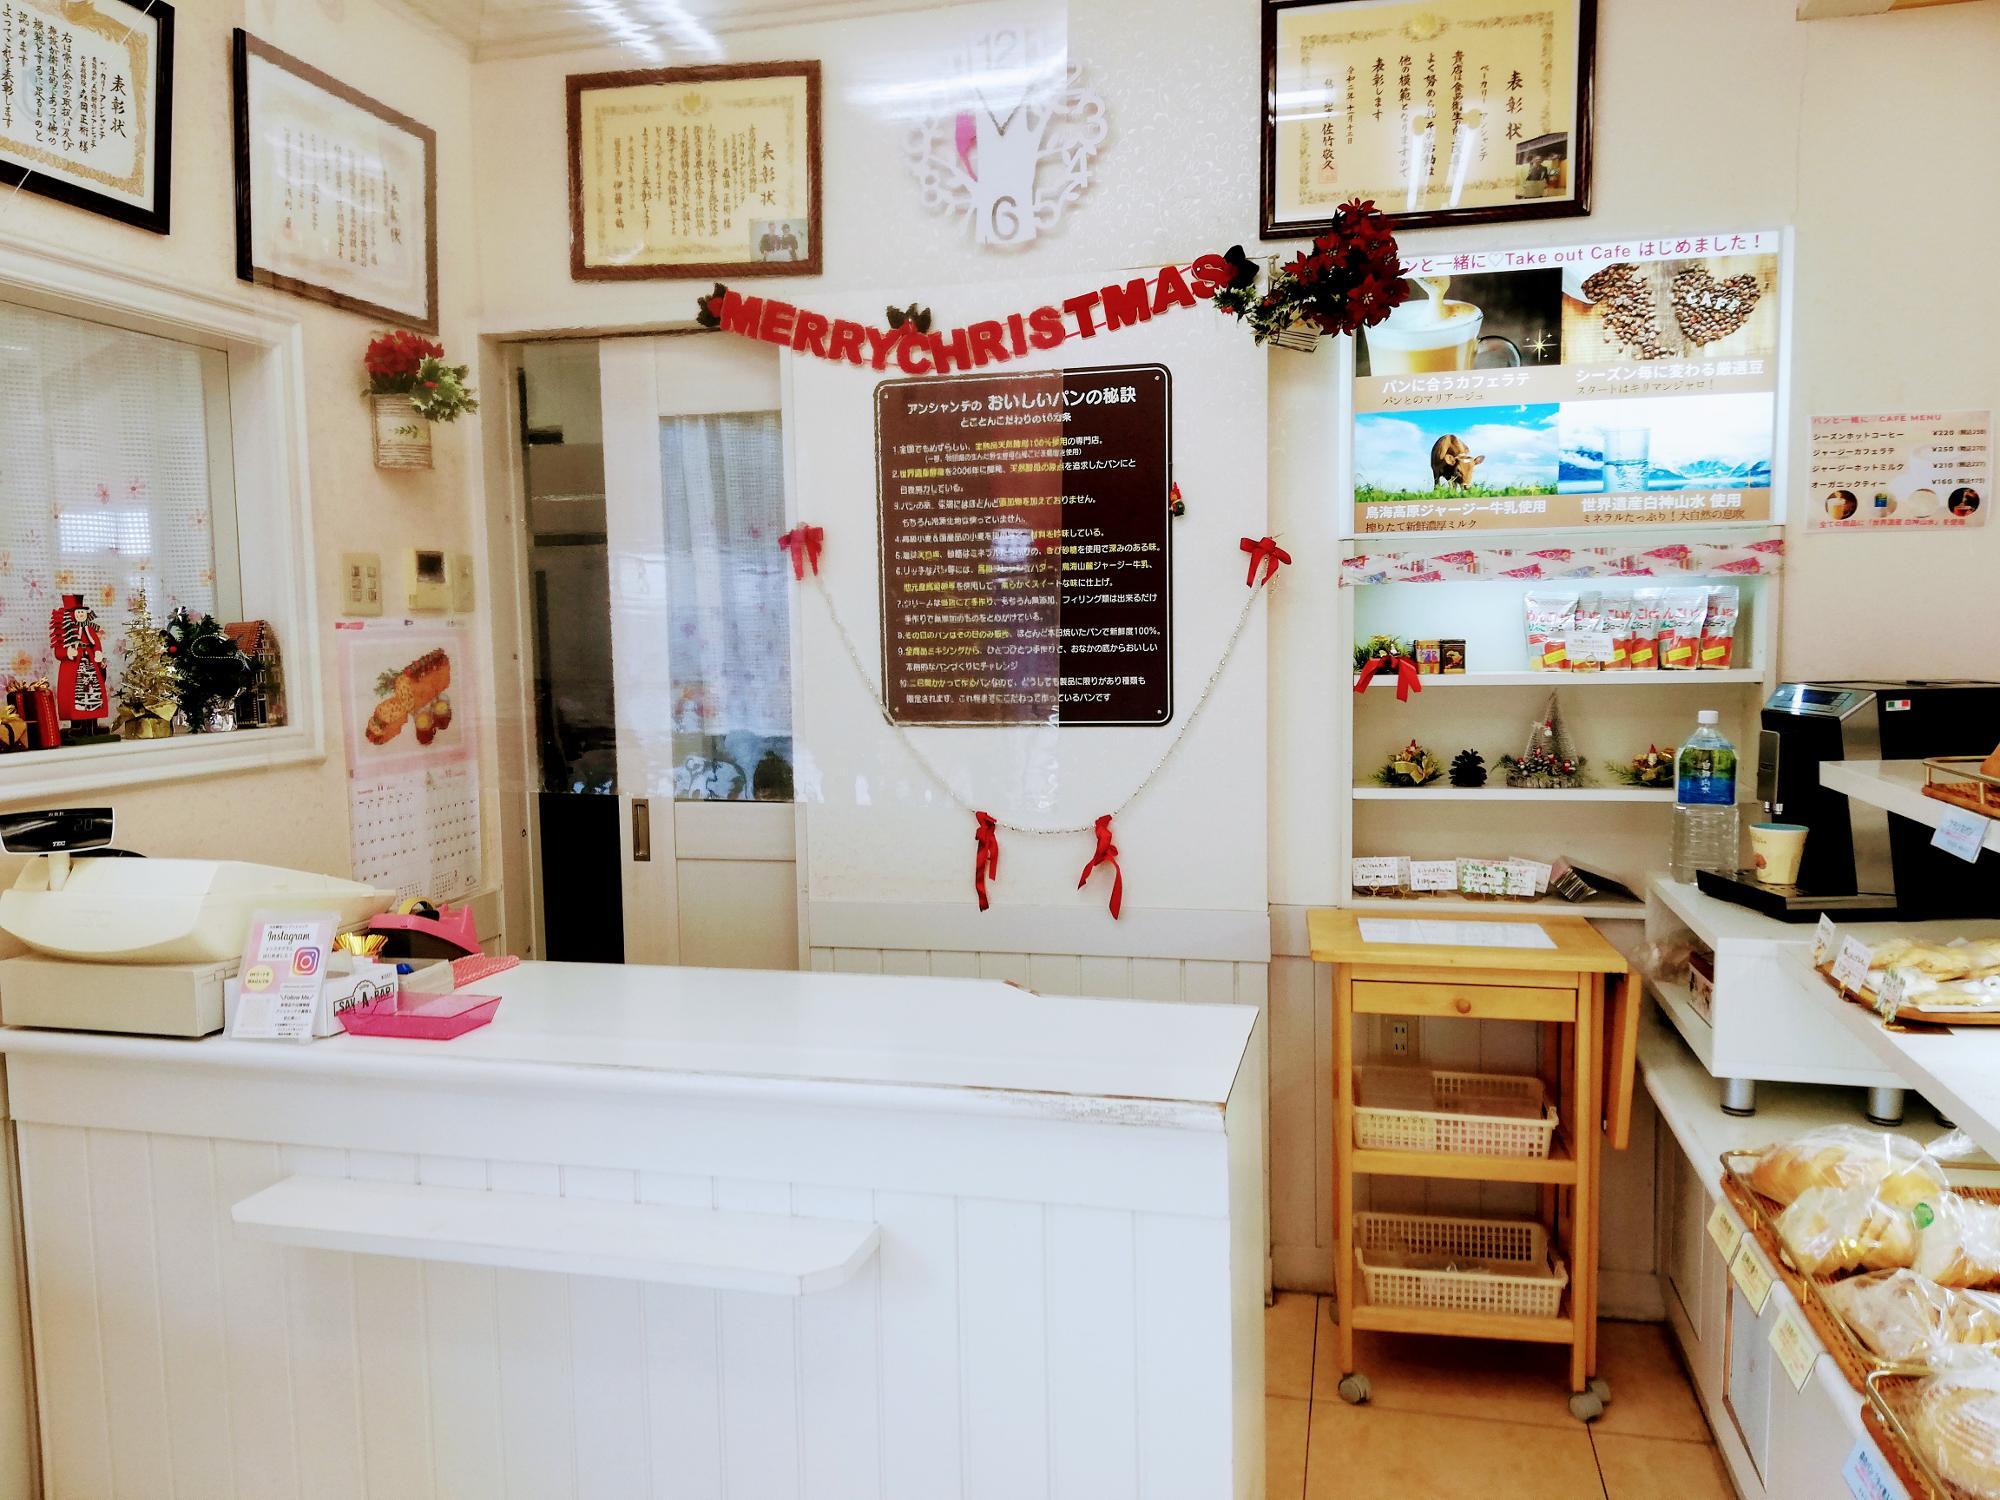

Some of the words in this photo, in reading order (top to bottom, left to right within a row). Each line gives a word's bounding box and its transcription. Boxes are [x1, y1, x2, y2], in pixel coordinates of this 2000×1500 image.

[17, 11, 29, 67] 認めます
[1372, 57, 1385, 121] 表彰します
[1480, 64, 1489, 103] ベーカリー
[110, 74, 127, 139] 表彰状
[1505, 69, 1524, 140] 表彰状
[1322, 122, 1335, 170] 佐竹敬久
[760, 141, 776, 206] 表彰状
[991, 195, 1020, 241] 6
[1402, 253, 1486, 274] ンと一緒に
[1505, 251, 1547, 266] Take
[1554, 247, 1584, 263] out
[1590, 244, 1631, 260] Cafe
[1639, 234, 1760, 257] はじめました！
[720, 288, 907, 371] MERRY
[898, 253, 1232, 374] CHRISTMAS
[1576, 359, 1765, 383] シーズン毎に変わる厳選豆
[1382, 372, 1531, 394] パンに合うカフェラテ
[1577, 379, 1714, 396] スタートはキリマンジャロ！
[907, 400, 983, 415] アンシャンテの
[987, 386, 1137, 411] おいしいパンの秘訣
[1383, 391, 1485, 406] パンとのマリアージュ
[1910, 414, 1942, 422] MENU
[1813, 431, 1905, 440] シーズンホットコーヒー
[1812, 447, 1895, 457] ジャージーカフェラテ
[1811, 463, 1905, 472] ジャージーホットミルク
[1811, 480, 1887, 488] オーガニックティー
[1366, 499, 1547, 520] 鳥海高原ジャージー牛乳使用
[1581, 493, 1706, 513] 世界遺産白神山水
[1709, 493, 1742, 508] 使用
[1366, 519, 1478, 533] 搾りたて新鮮濃厚ミルク
[267, 930, 311, 945] Instagram
